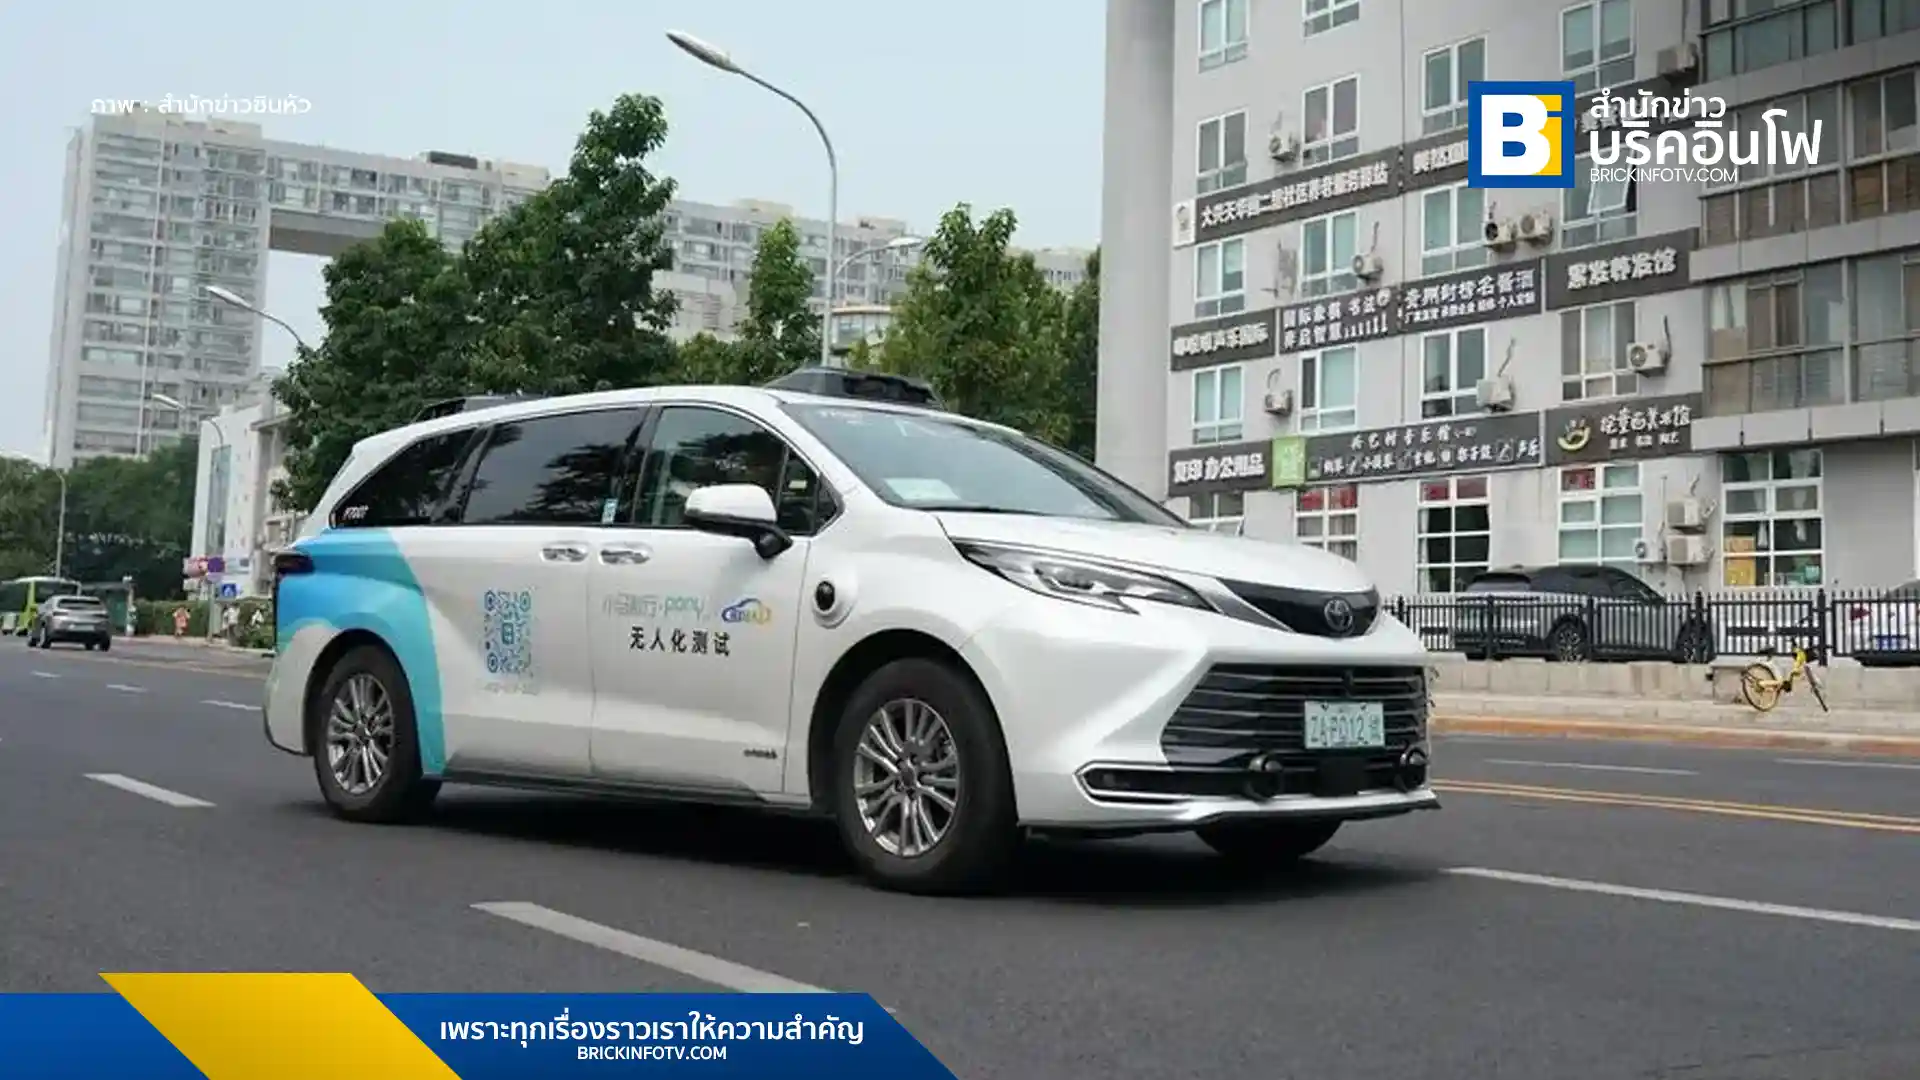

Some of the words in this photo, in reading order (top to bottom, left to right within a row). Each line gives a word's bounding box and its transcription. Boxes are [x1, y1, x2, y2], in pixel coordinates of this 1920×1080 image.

[1205, 453, 1265, 480] 办公用品
[630, 626, 730, 656] 无人化测试
